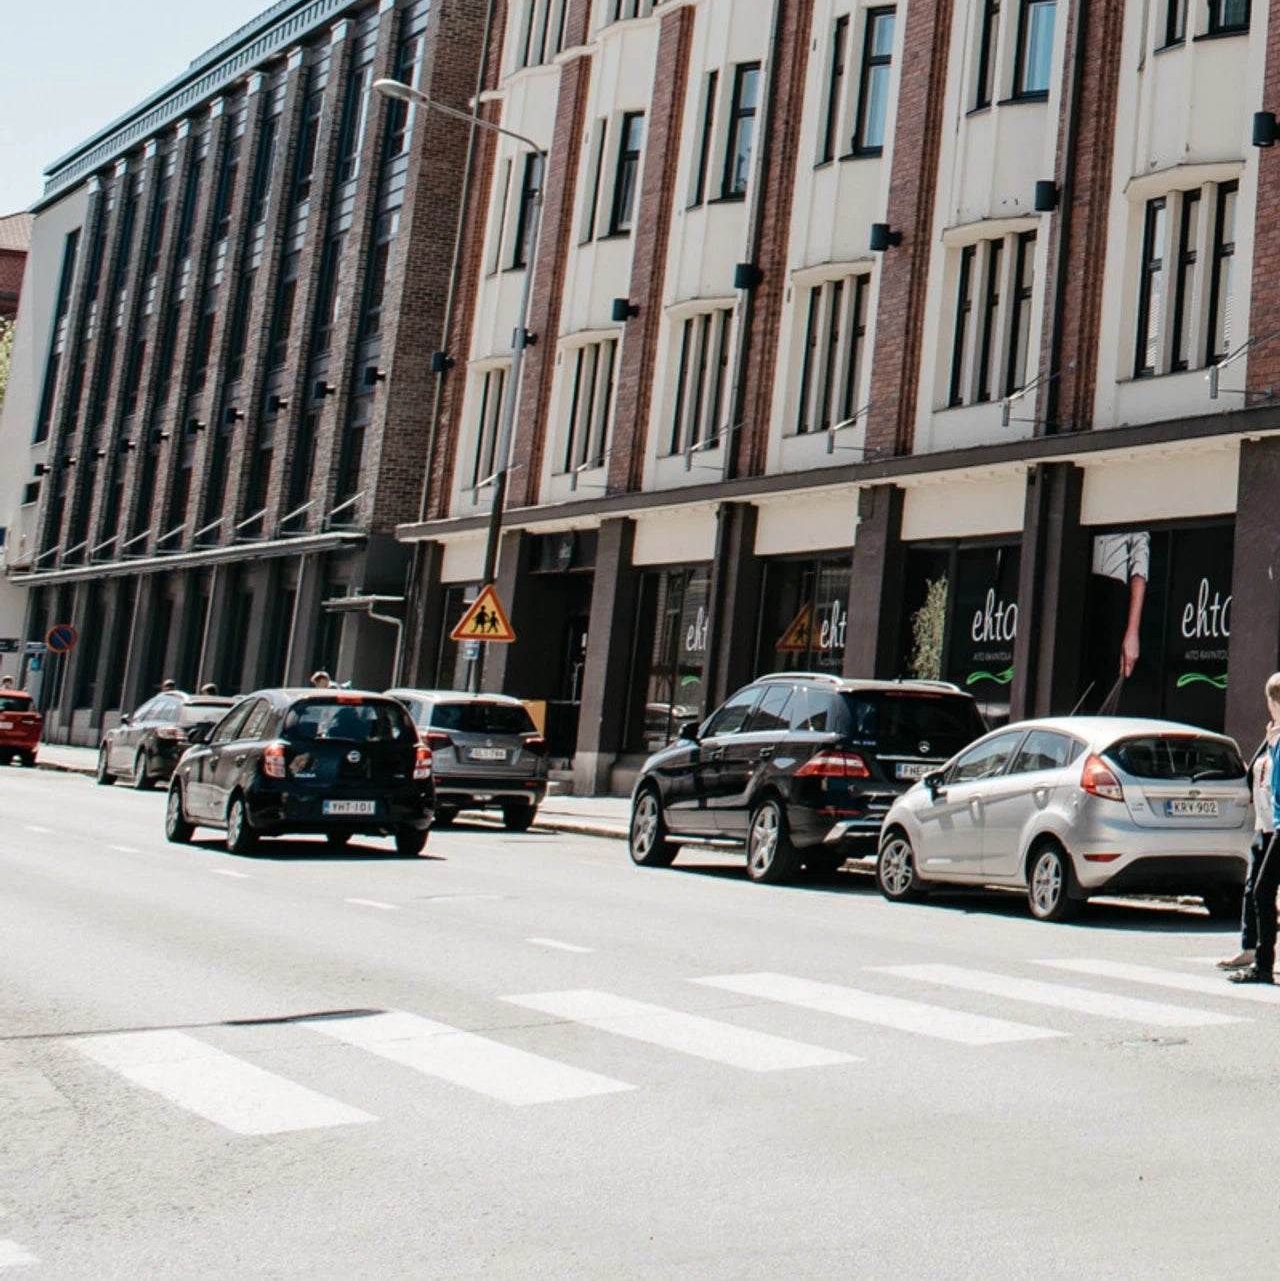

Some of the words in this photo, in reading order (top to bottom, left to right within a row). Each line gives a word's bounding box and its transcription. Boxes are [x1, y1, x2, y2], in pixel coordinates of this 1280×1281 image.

[685, 606, 710, 651] eht
[820, 599, 848, 648] eht
[972, 587, 1019, 642] ehta
